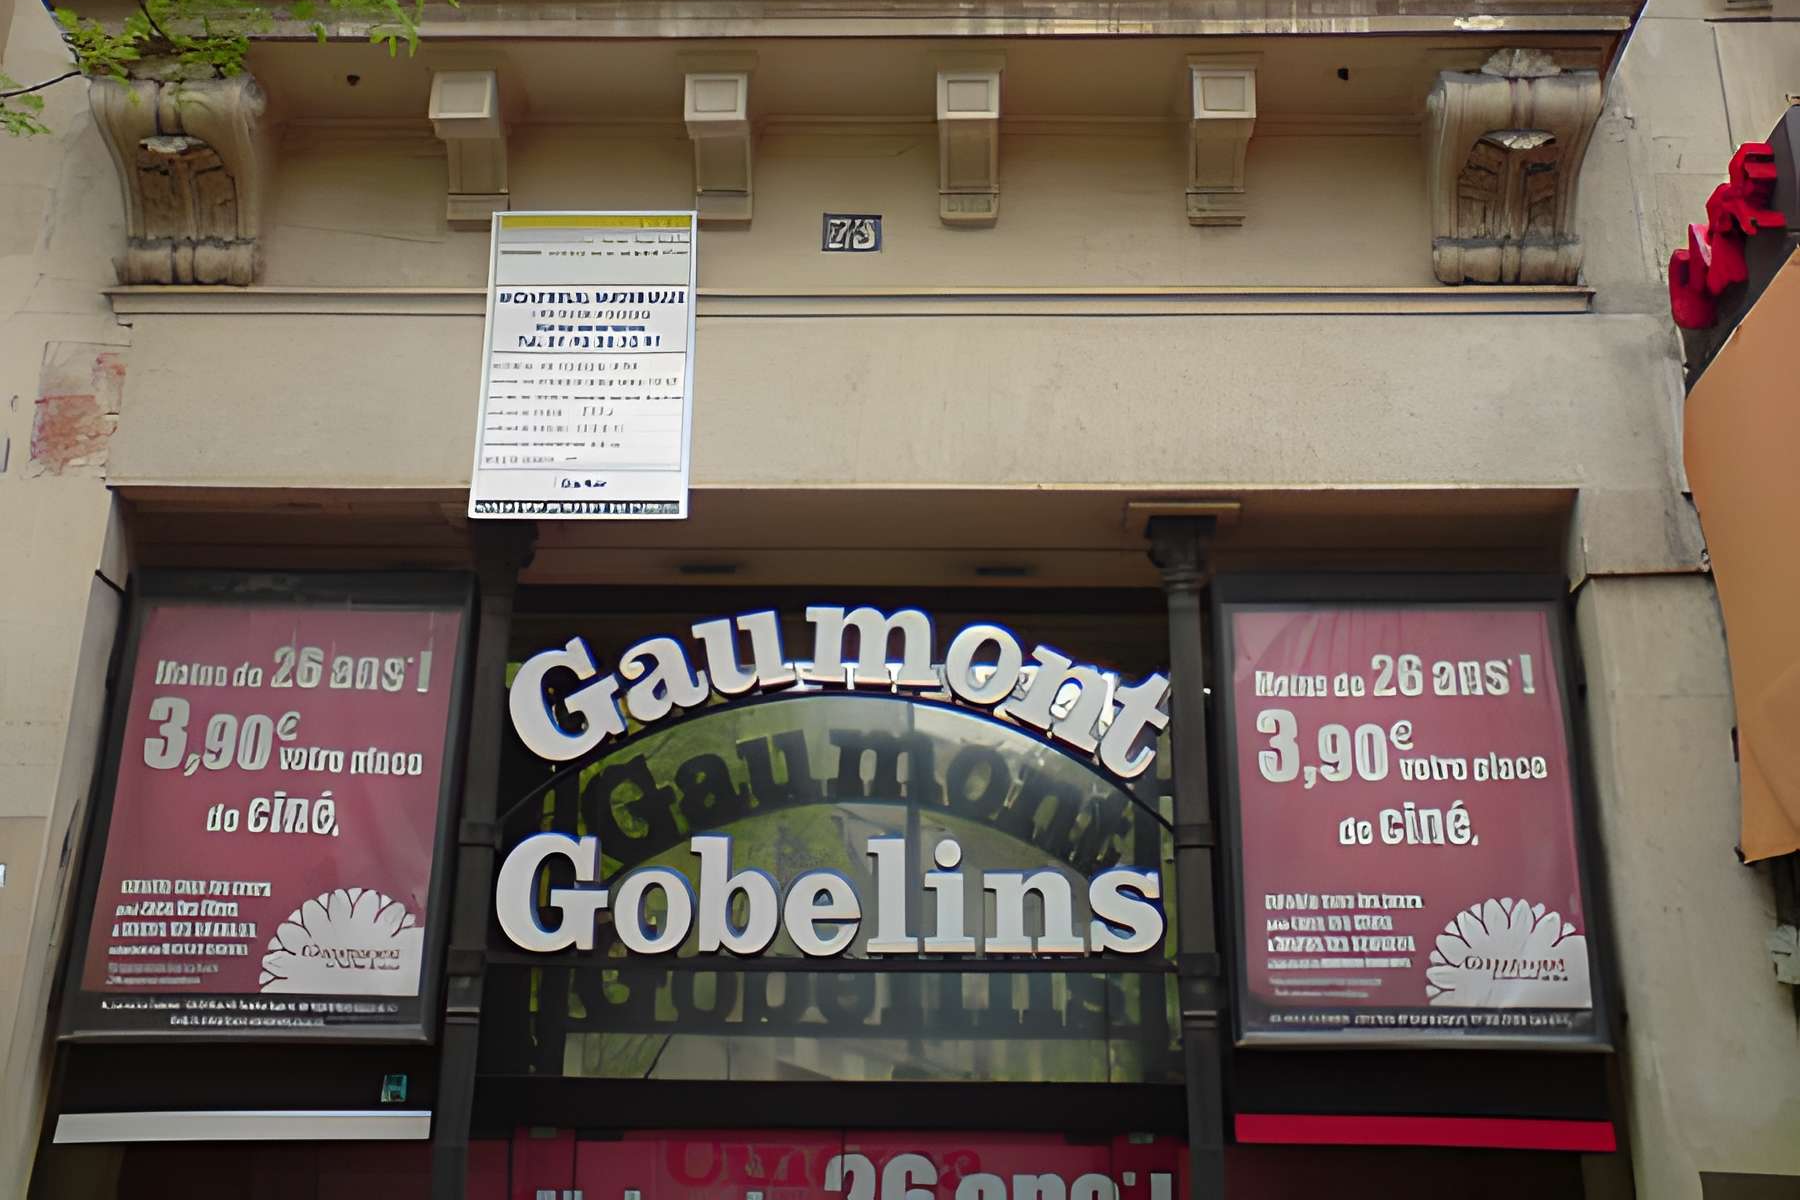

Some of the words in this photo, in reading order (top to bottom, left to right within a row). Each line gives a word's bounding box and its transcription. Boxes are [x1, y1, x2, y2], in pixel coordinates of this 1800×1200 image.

[271, 646, 325, 688] 26
[507, 605, 1171, 779] Gaumont
[1371, 654, 1424, 696] 26
[495, 832, 1168, 957] Gobelins
